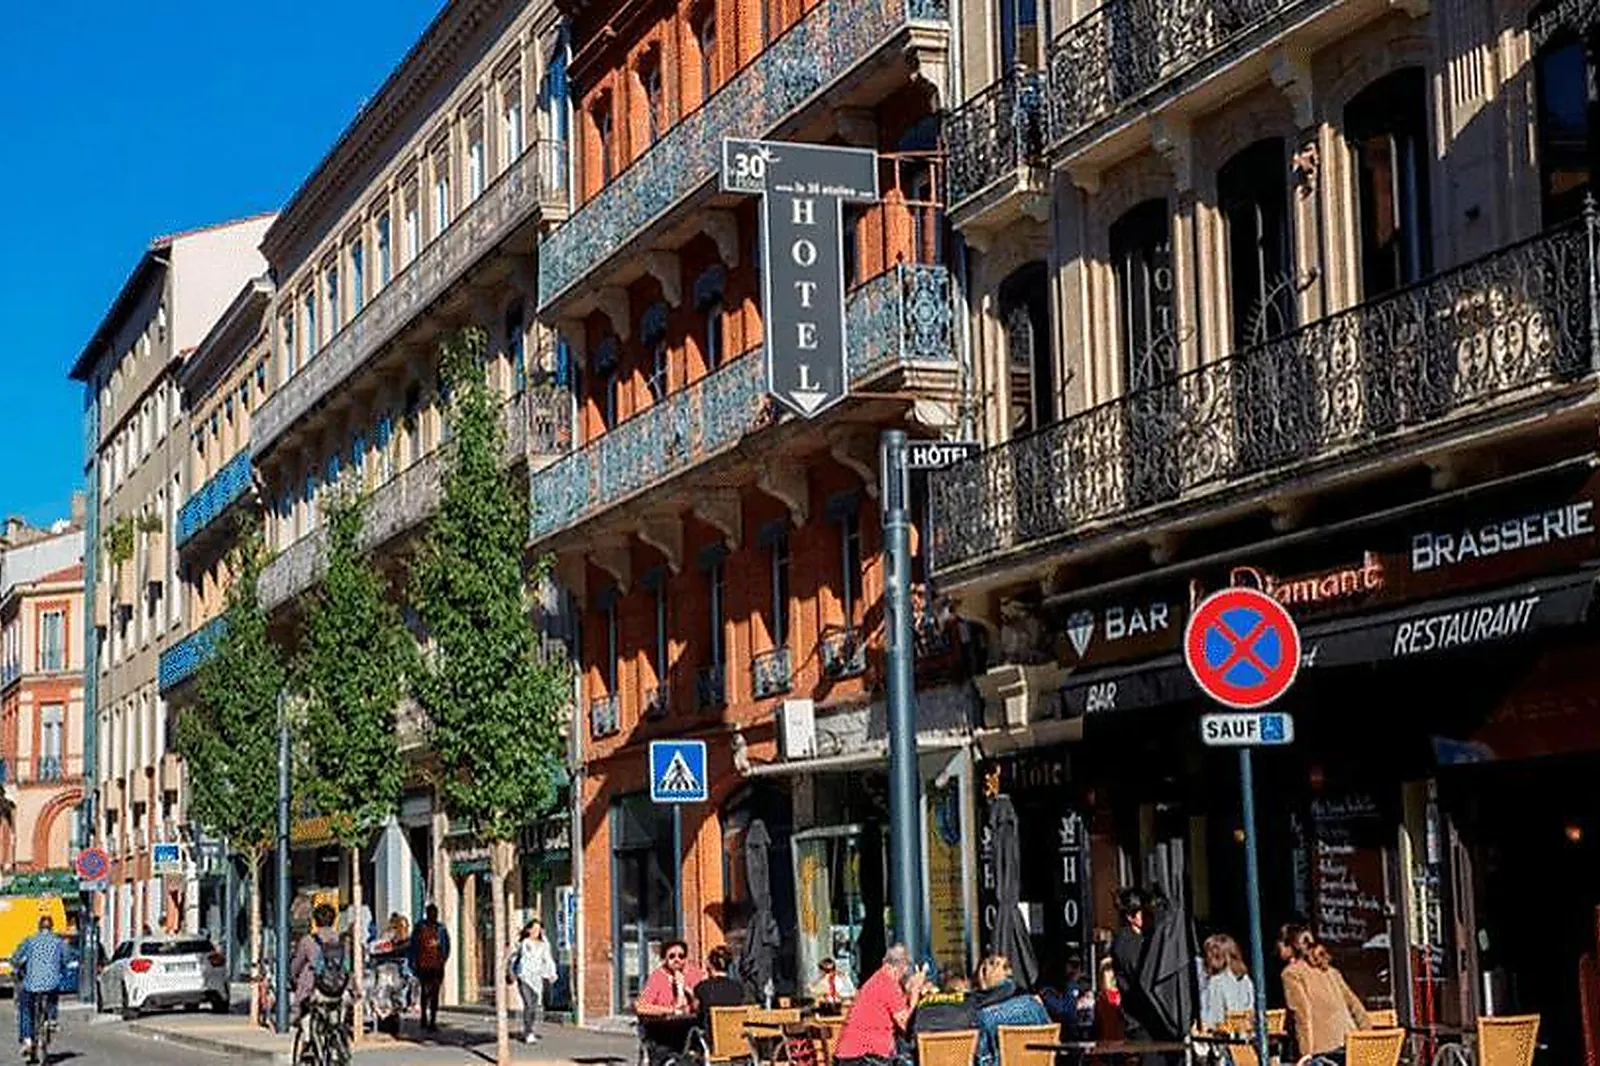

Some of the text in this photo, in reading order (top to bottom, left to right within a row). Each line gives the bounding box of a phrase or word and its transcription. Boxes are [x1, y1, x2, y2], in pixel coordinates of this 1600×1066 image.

[735, 153, 765, 178] 30
[791, 199, 820, 391] HOTEL
[1411, 500, 1595, 572] BRASSERIE
[1105, 602, 1169, 640] BAR
[1392, 595, 1540, 657] RESTAURANT
[1085, 681, 1118, 712] BAR
[1206, 719, 1257, 738] SAUF
